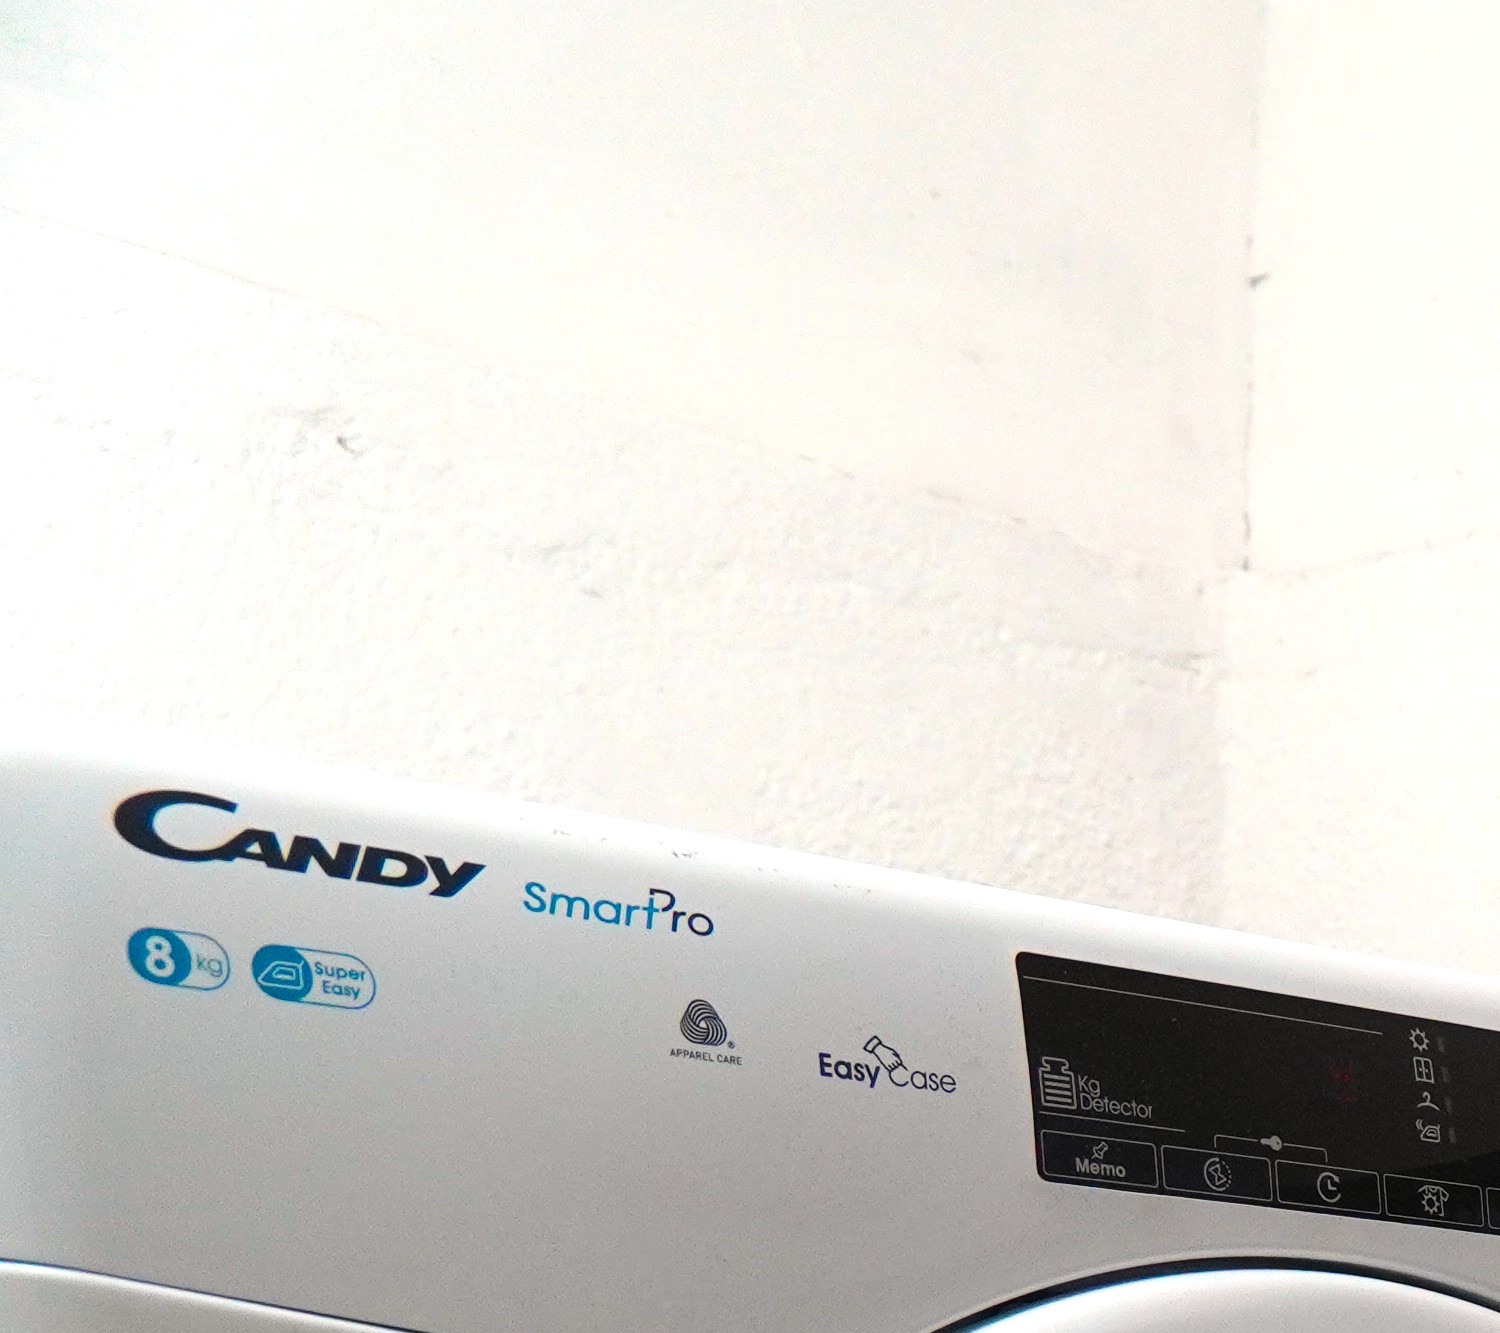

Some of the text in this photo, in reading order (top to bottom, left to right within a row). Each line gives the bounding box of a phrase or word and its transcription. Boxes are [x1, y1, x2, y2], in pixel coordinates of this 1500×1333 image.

[114, 790, 488, 898] CANDY
[145, 935, 223, 977] 8 kg
[314, 962, 366, 982] Super
[322, 980, 360, 1000] Easy
[669, 1048, 742, 1066] APPAREL CARE
[1078, 1075, 1100, 1097] Kg
[1079, 1093, 1153, 1119] Detector
[1075, 1157, 1126, 1178] Memo
